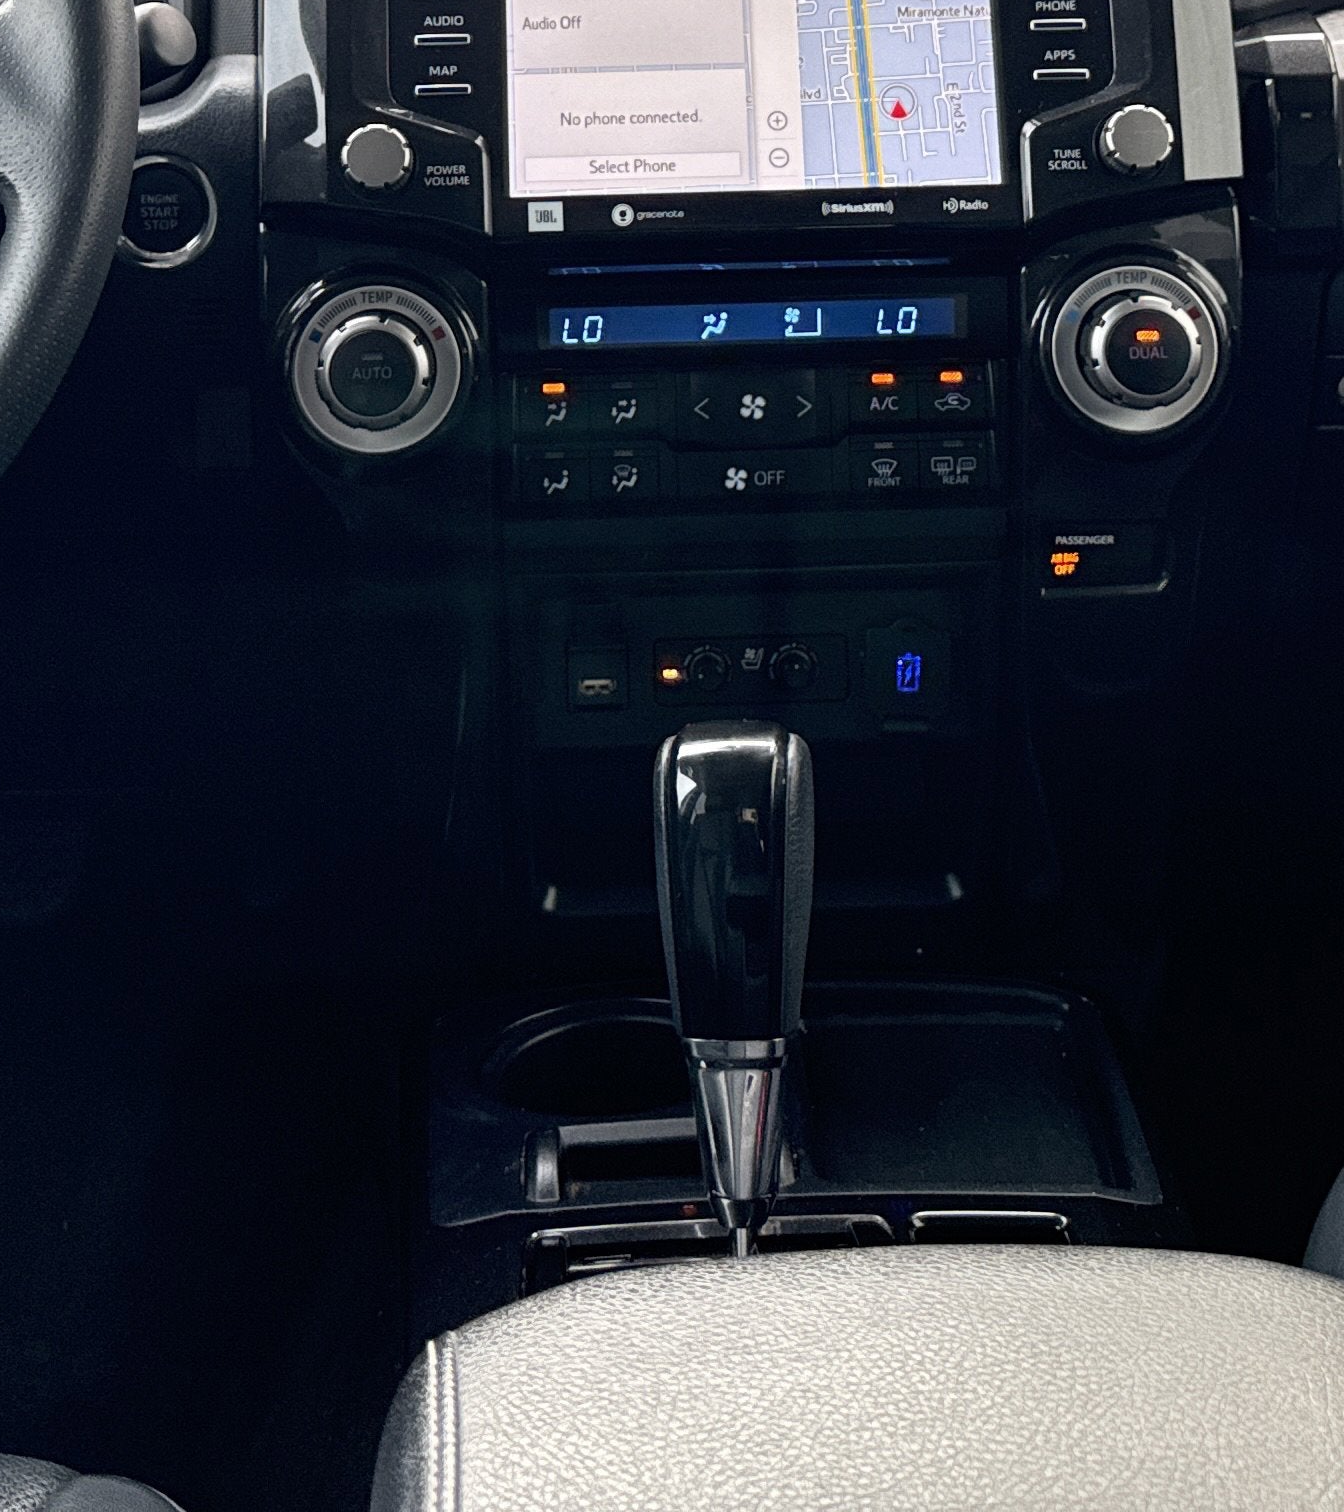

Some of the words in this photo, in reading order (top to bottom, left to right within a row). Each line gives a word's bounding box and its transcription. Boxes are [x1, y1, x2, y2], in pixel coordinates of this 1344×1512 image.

[897, 4, 960, 18] Miramonte
[1035, 0, 1077, 11] PHONE
[423, 14, 465, 28] AUDIO
[522, 16, 557, 31] Audio
[559, 15, 582, 30] Off
[1044, 49, 1076, 61] APPS
[428, 65, 458, 77] MAP
[560, 111, 581, 126] No
[584, 112, 626, 129] phone
[629, 109, 703, 125] connected.
[1053, 148, 1082, 159] TUNE
[426, 164, 467, 176] POWER
[589, 159, 630, 174] Select
[633, 158, 677, 173] Phone
[1047, 159, 1089, 171] SCROLL
[424, 175, 471, 187] VOLUME
[140, 194, 179, 204] ENGINE
[959, 199, 989, 211] Radio
[140, 206, 180, 218] START
[535, 209, 557, 224] JBL
[636, 209, 685, 221] gracenote
[144, 219, 178, 230] STOP
[1115, 270, 1148, 285] TEMP
[360, 290, 393, 305] TEMP
[875, 305, 919, 335] LO
[562, 314, 603, 344] LO
[1128, 345, 1169, 361] DUAL
[351, 366, 393, 379] AUTO
[869, 395, 899, 412] A/C
[754, 469, 786, 488] OFF
[867, 476, 902, 489] FRONT
[940, 473, 970, 486] REAR
[1055, 534, 1115, 546] PASSENGER
[1053, 564, 1076, 576] OFF
